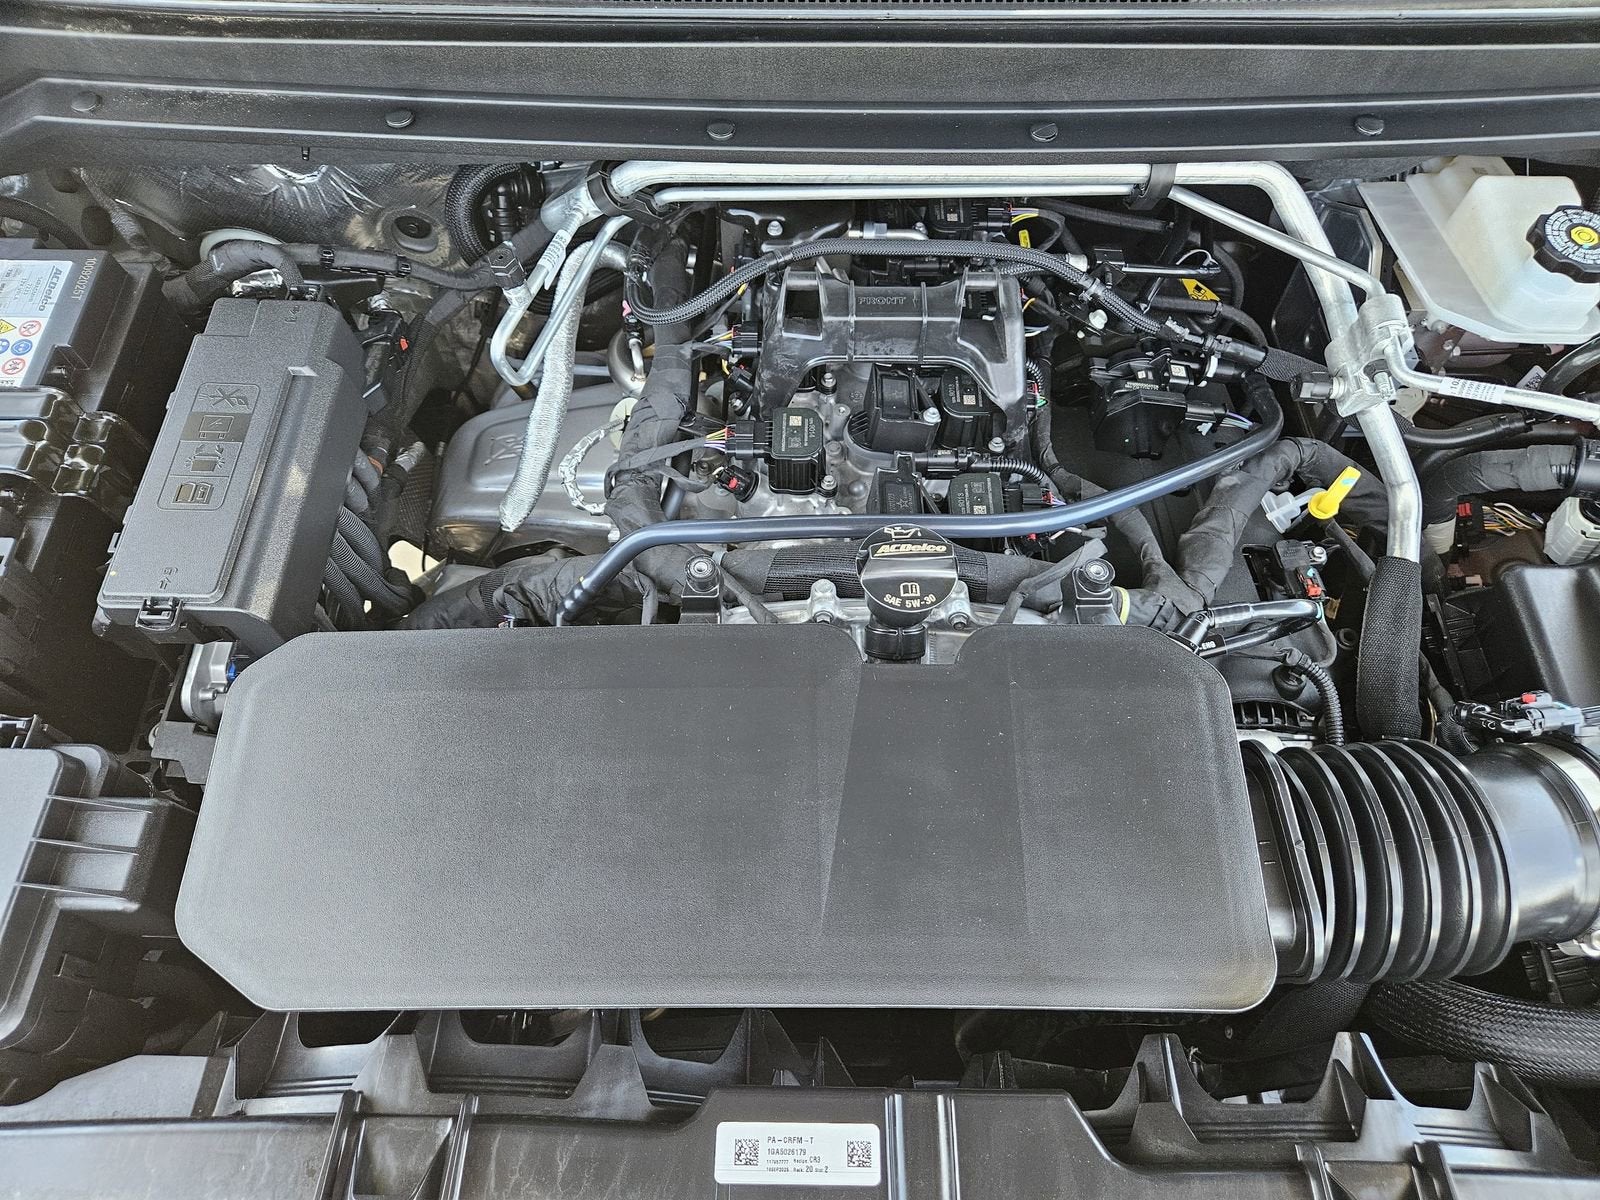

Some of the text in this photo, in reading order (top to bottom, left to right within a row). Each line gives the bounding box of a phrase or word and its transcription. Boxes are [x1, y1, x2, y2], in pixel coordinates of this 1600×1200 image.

[72, 257, 97, 300] 10092025T
[38, 267, 63, 311] ACDelco
[858, 296, 907, 305] FRONT
[875, 543, 947, 554] ACDelco
[884, 594, 936, 608] SAE 5W-30
